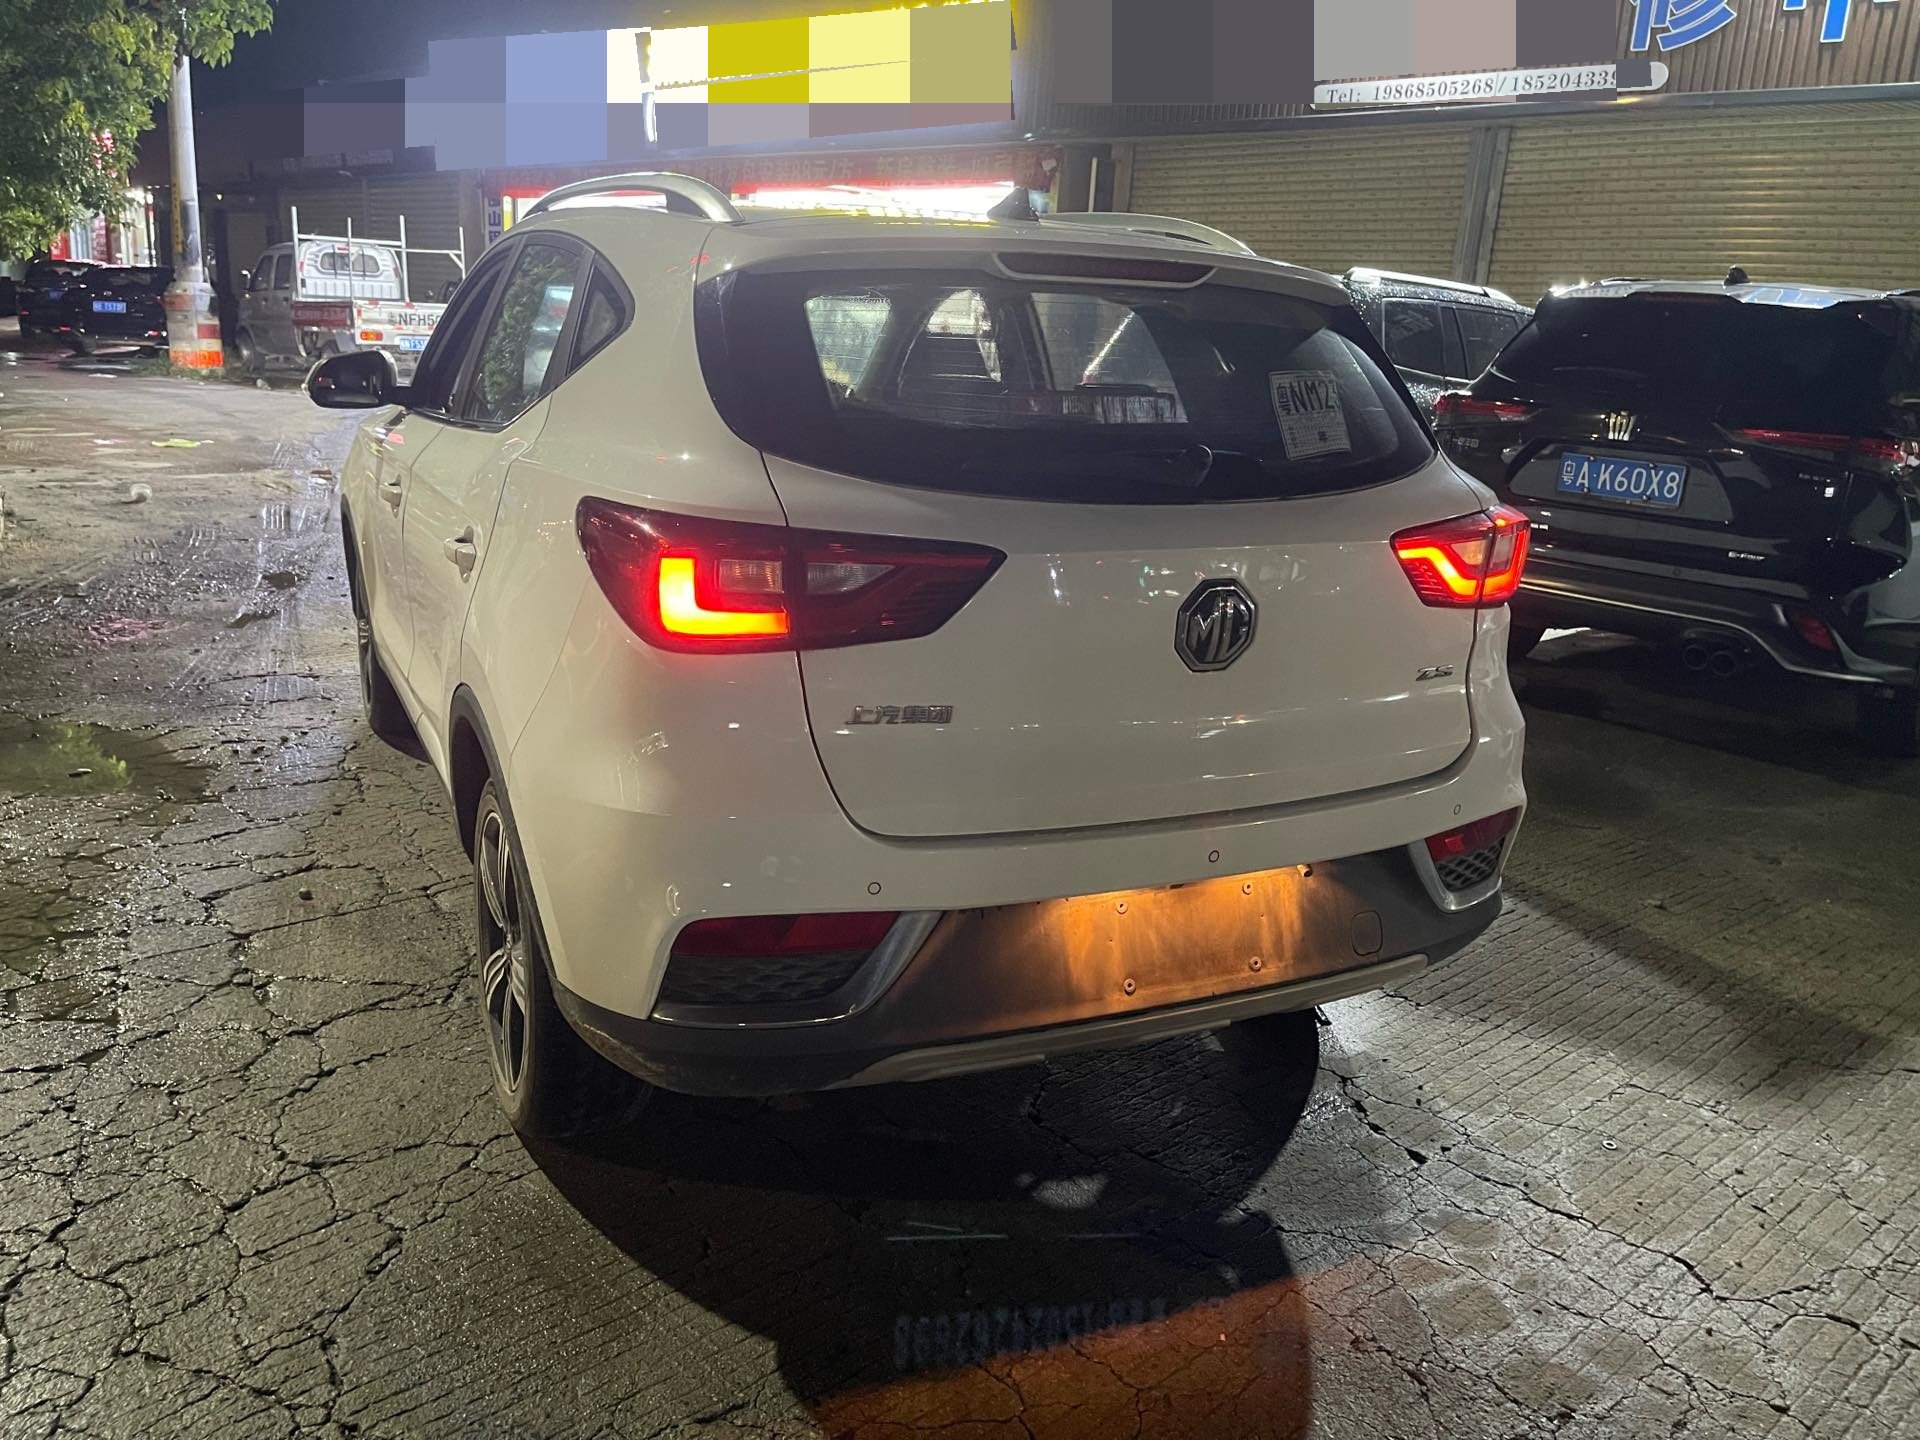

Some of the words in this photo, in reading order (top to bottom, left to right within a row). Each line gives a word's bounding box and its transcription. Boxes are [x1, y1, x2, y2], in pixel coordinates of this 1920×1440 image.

[1327, 89, 1361, 103] Tel:
[845, 705, 954, 725] 上汽集团
